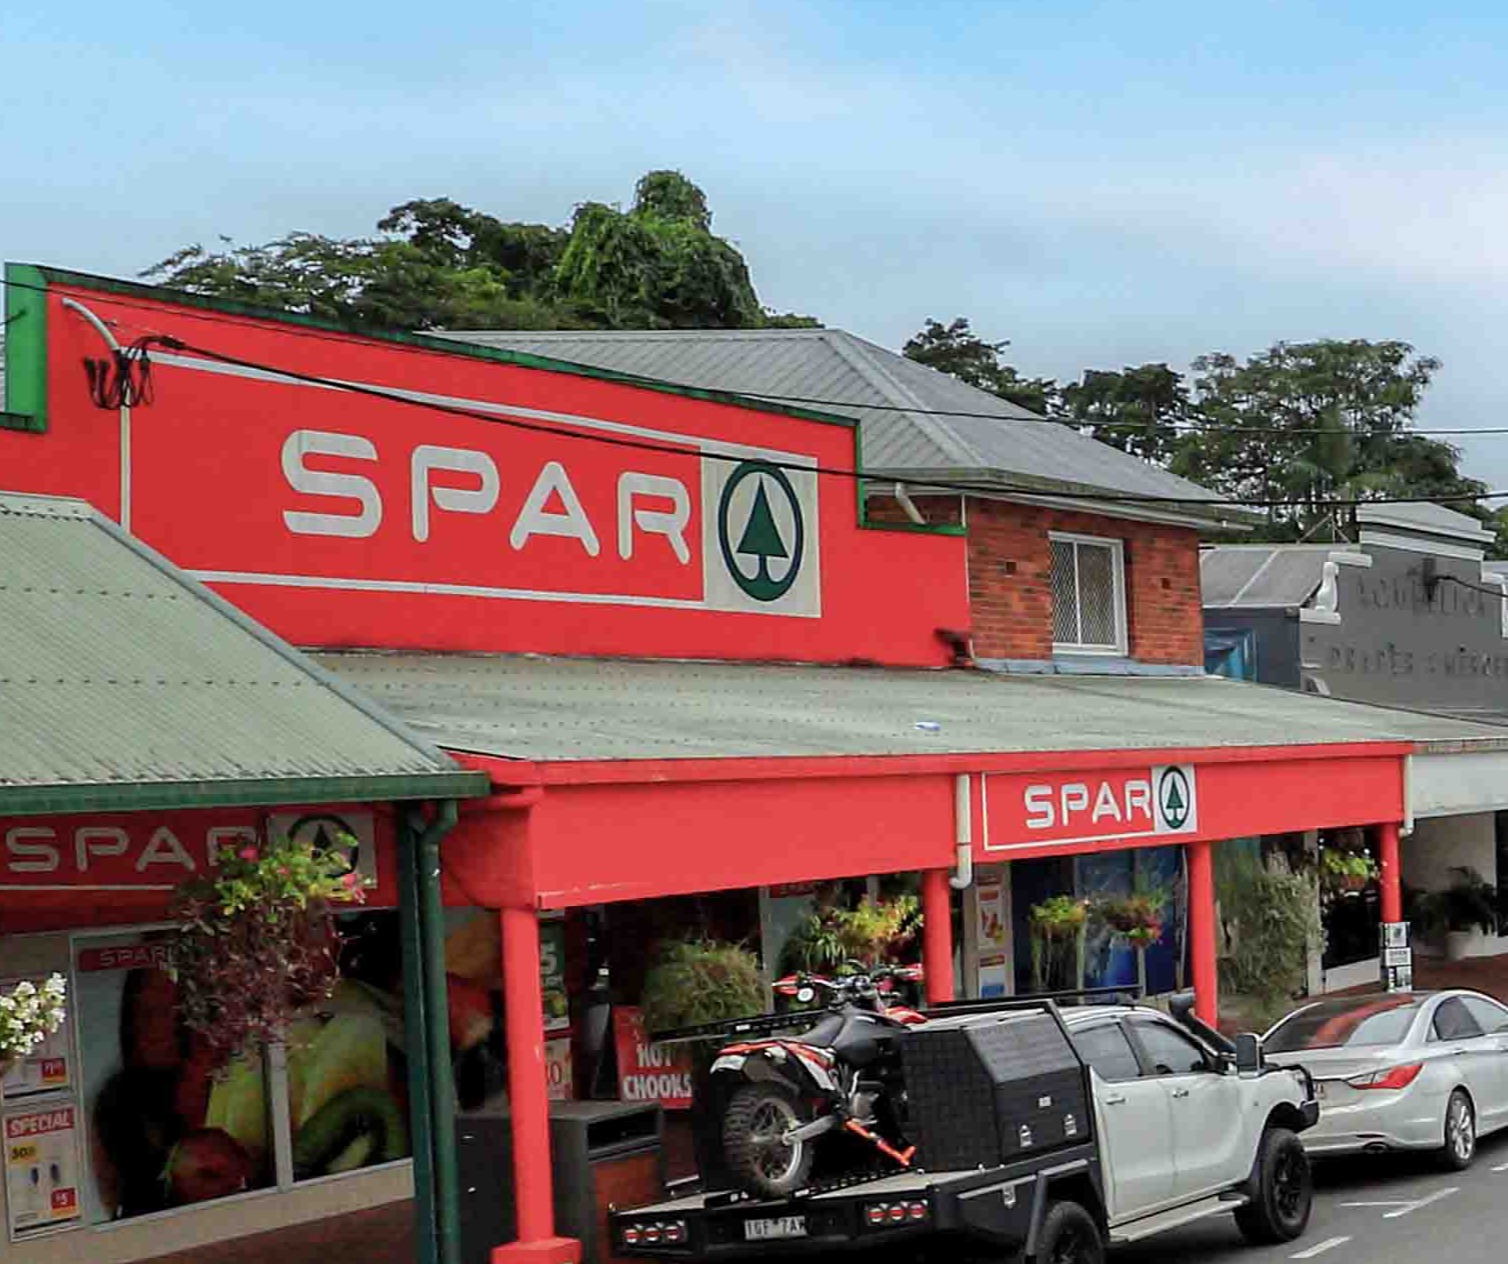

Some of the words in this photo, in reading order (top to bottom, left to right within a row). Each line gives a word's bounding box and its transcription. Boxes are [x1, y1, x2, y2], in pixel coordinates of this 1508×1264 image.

[281, 429, 692, 564] SPAR
[1024, 780, 1151, 829] SPAR
[637, 1043, 672, 1068] HOT
[622, 1073, 692, 1099] CHOOKS
[11, 1111, 70, 1136] SPECIAL
